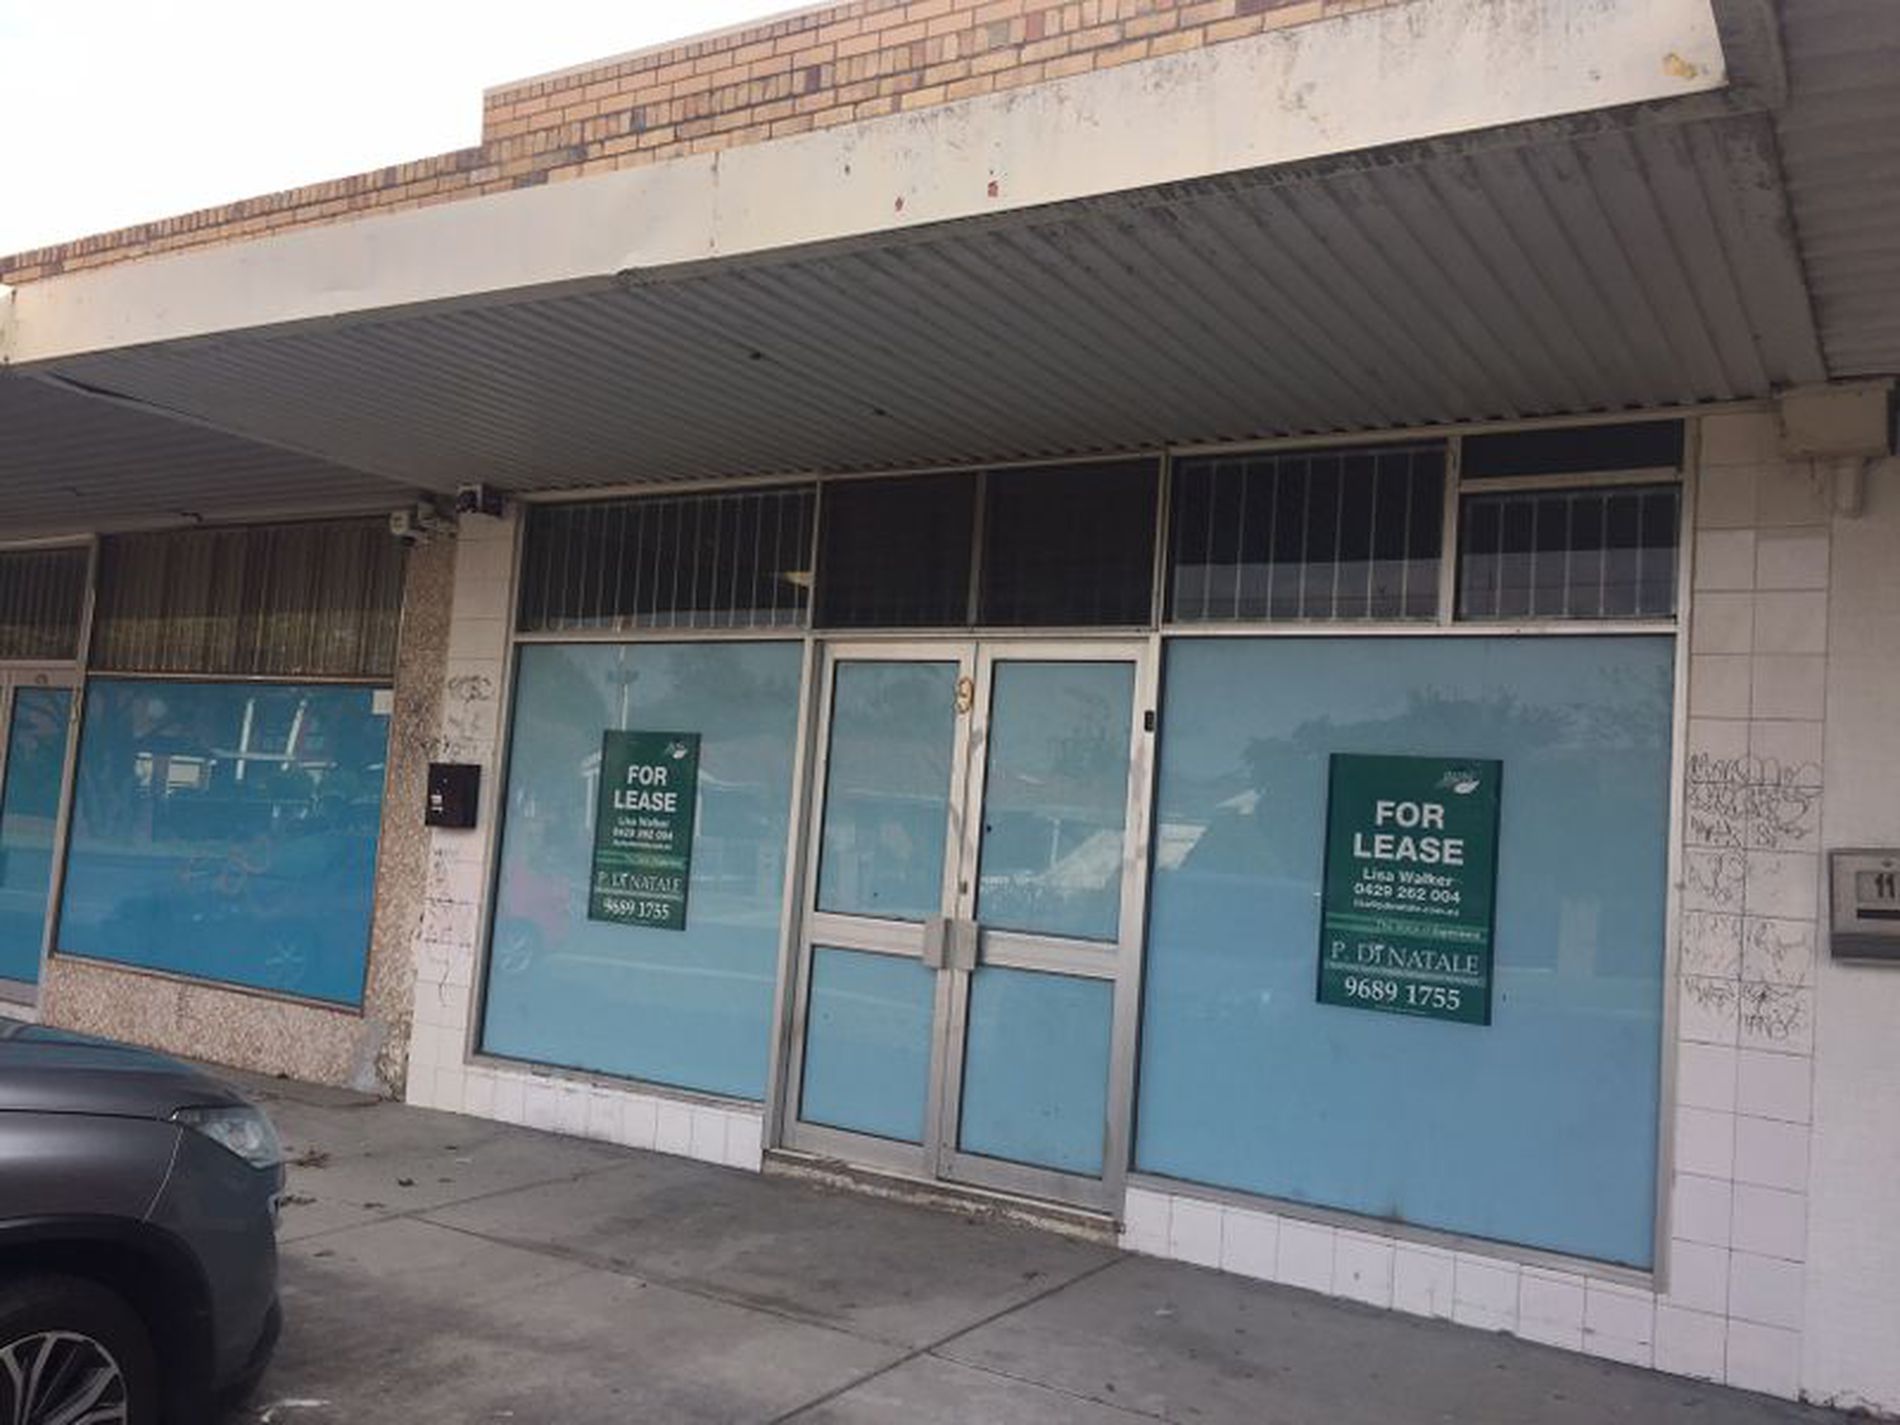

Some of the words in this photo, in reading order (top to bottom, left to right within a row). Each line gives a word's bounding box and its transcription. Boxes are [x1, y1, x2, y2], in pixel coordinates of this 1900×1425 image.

[957, 676, 974, 715] 9
[627, 765, 668, 786] FOR
[613, 789, 677, 813] LEASE
[1375, 800, 1444, 829] FOR
[1353, 832, 1464, 865] LEASE
[1363, 867, 1395, 882] Lisa
[1399, 870, 1454, 887] Walker
[1388, 947, 1479, 975] NATALE
[1344, 975, 1398, 1001] 9689
[1406, 984, 1461, 1010] 1755
